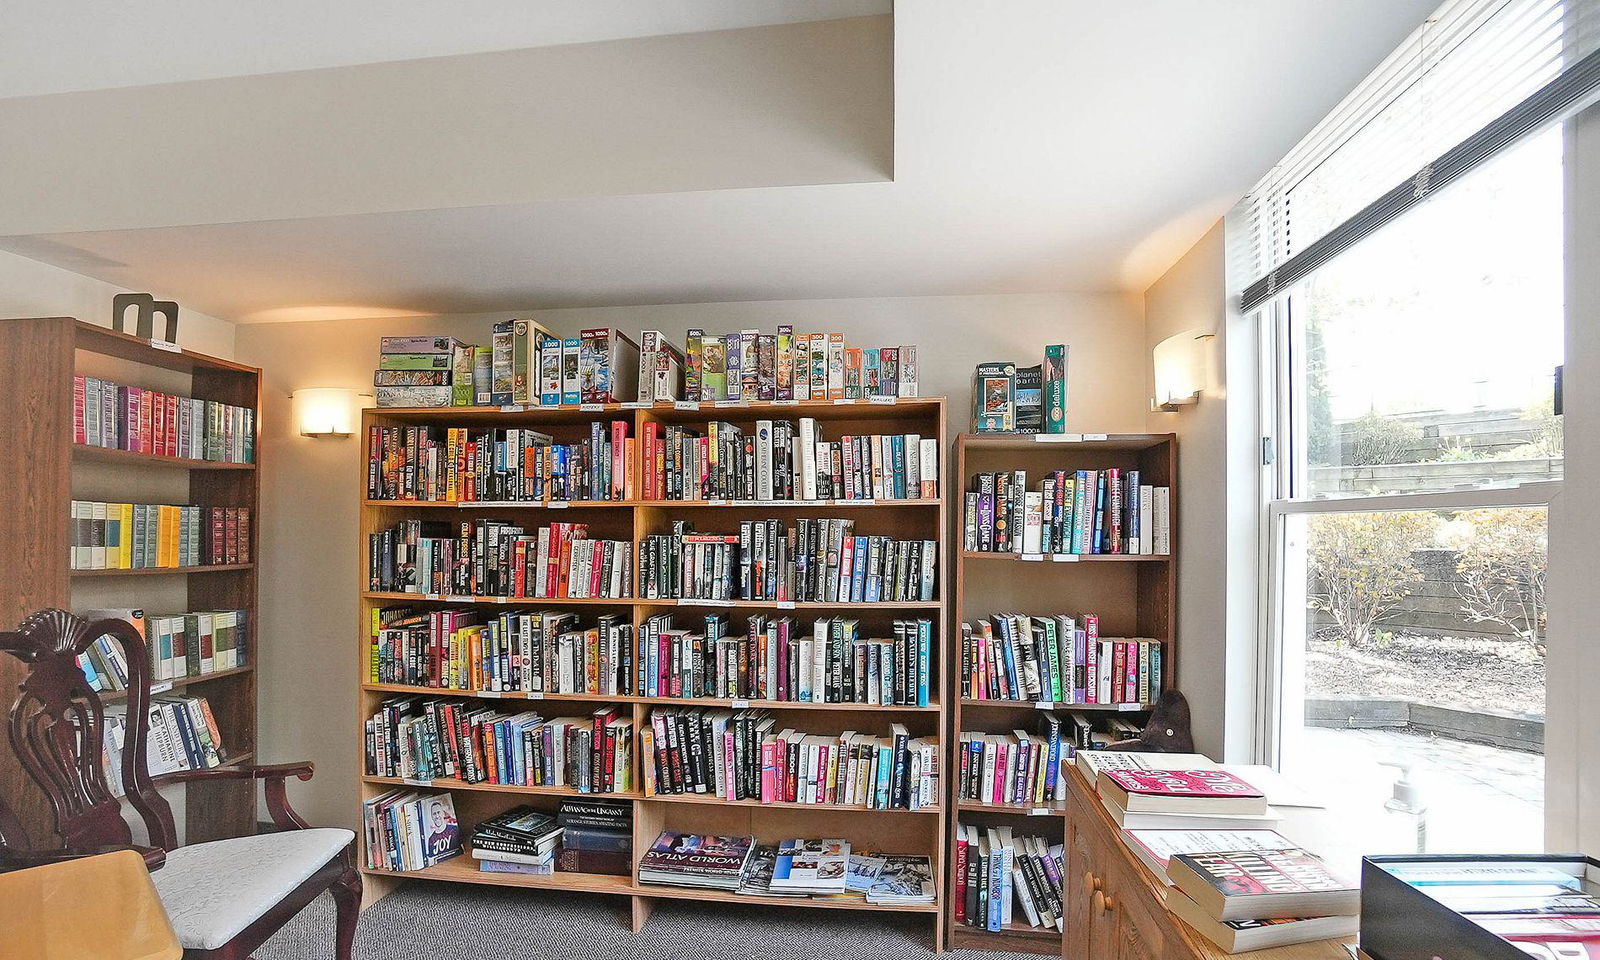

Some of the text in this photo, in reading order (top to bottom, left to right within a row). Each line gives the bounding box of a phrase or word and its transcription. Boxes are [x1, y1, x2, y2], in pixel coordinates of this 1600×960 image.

[997, 474, 1008, 494] Nelson
[1112, 478, 1120, 526] JANET EVANOVICH
[980, 525, 991, 543] GAME
[155, 732, 168, 762] HEPBURN
[161, 726, 176, 762] KATHARINE
[433, 835, 451, 854] JOY
[646, 852, 741, 865] WORLD ATLAS
[1184, 853, 1245, 878] FEAR
[1220, 851, 1300, 891] KILLING
